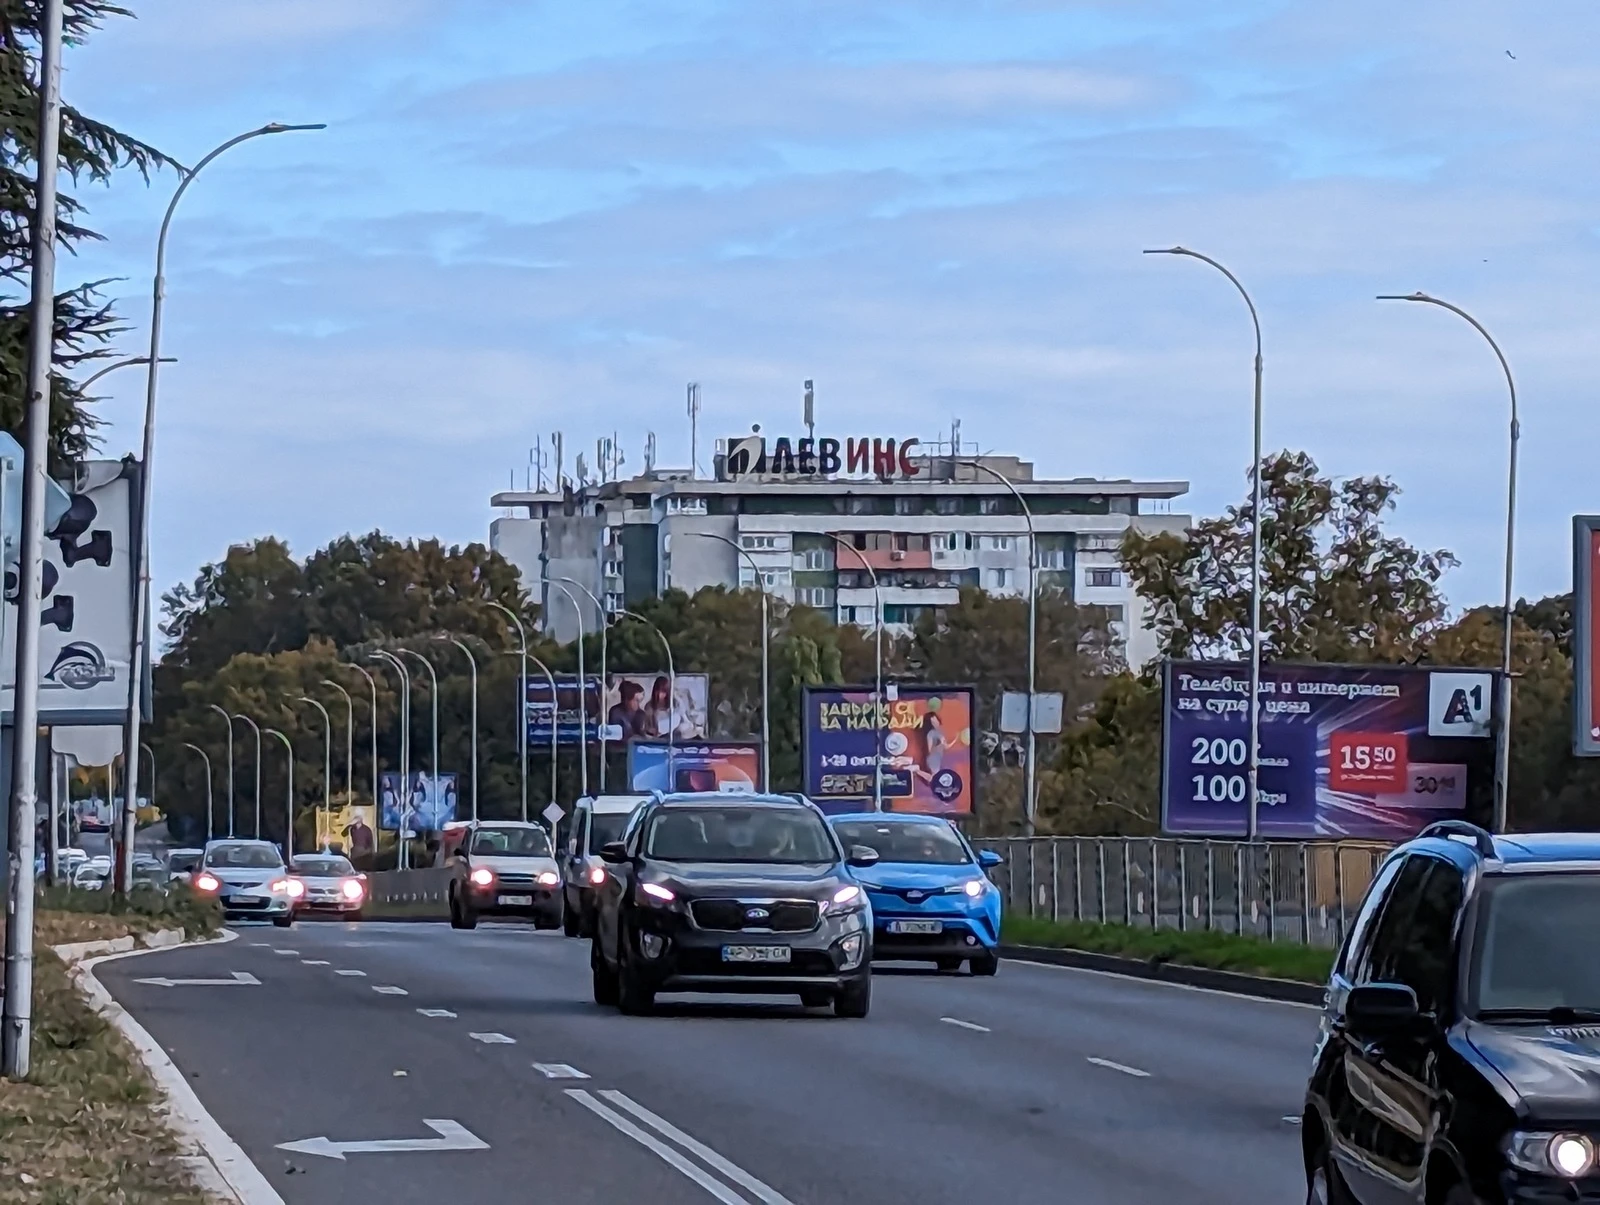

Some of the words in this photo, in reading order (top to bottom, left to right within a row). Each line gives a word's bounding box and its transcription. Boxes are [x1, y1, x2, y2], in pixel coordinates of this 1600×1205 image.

[1206, 699, 1260, 714] супе
[1442, 684, 1482, 724] A1
[1191, 737, 1247, 765] 200
[1191, 775, 1246, 802] 100
